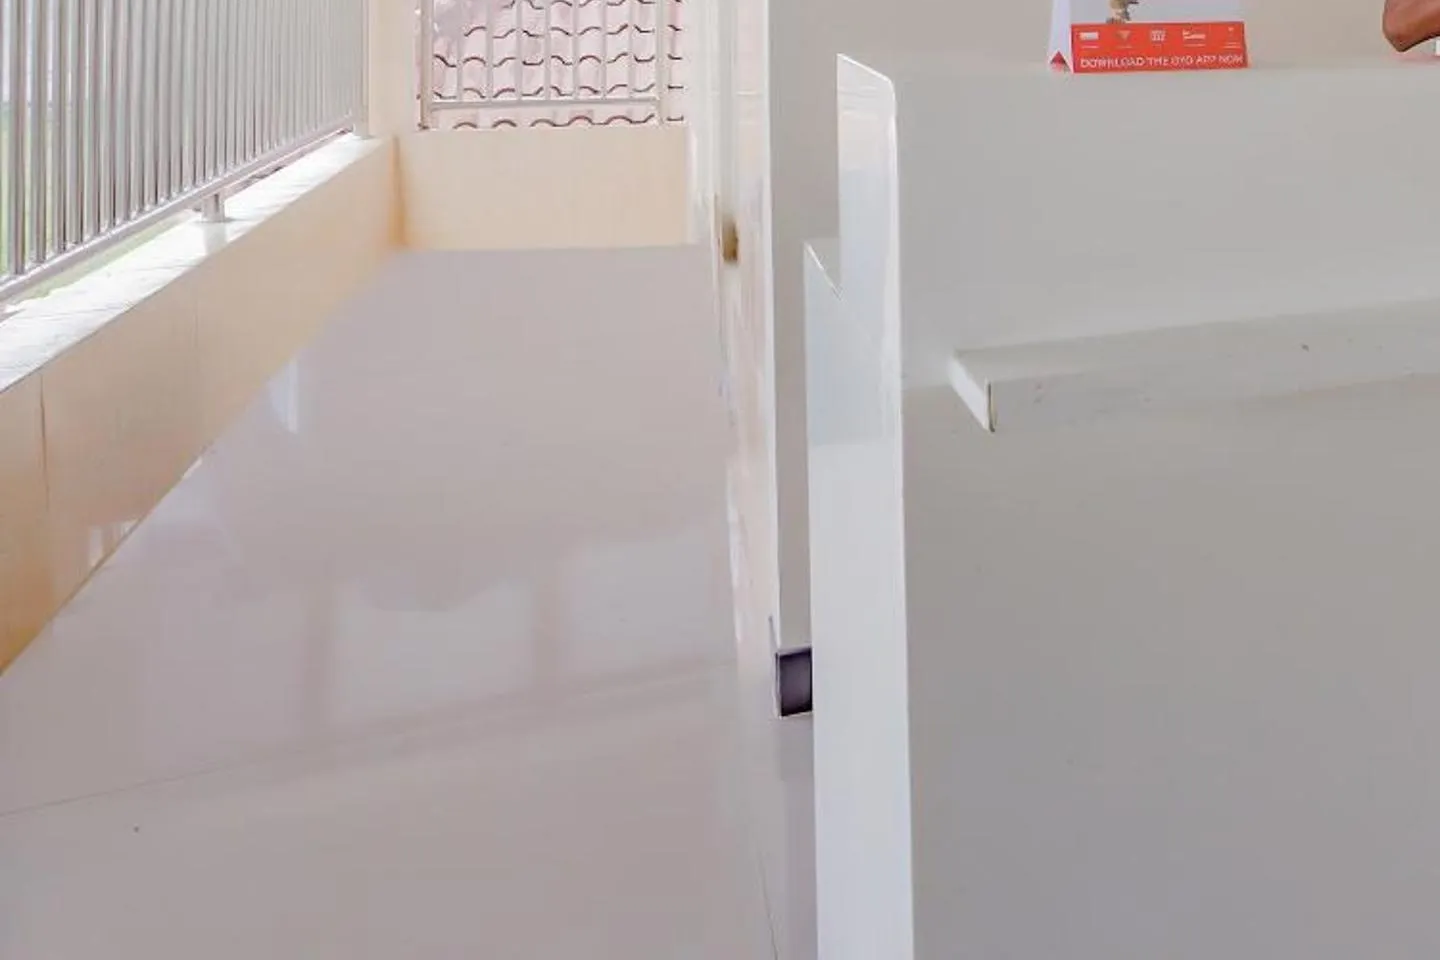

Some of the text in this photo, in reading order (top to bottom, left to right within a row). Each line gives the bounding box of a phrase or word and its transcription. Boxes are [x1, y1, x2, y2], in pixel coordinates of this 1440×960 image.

[1080, 54, 1244, 69] DOWNLOAD THE OYO APP NOW
